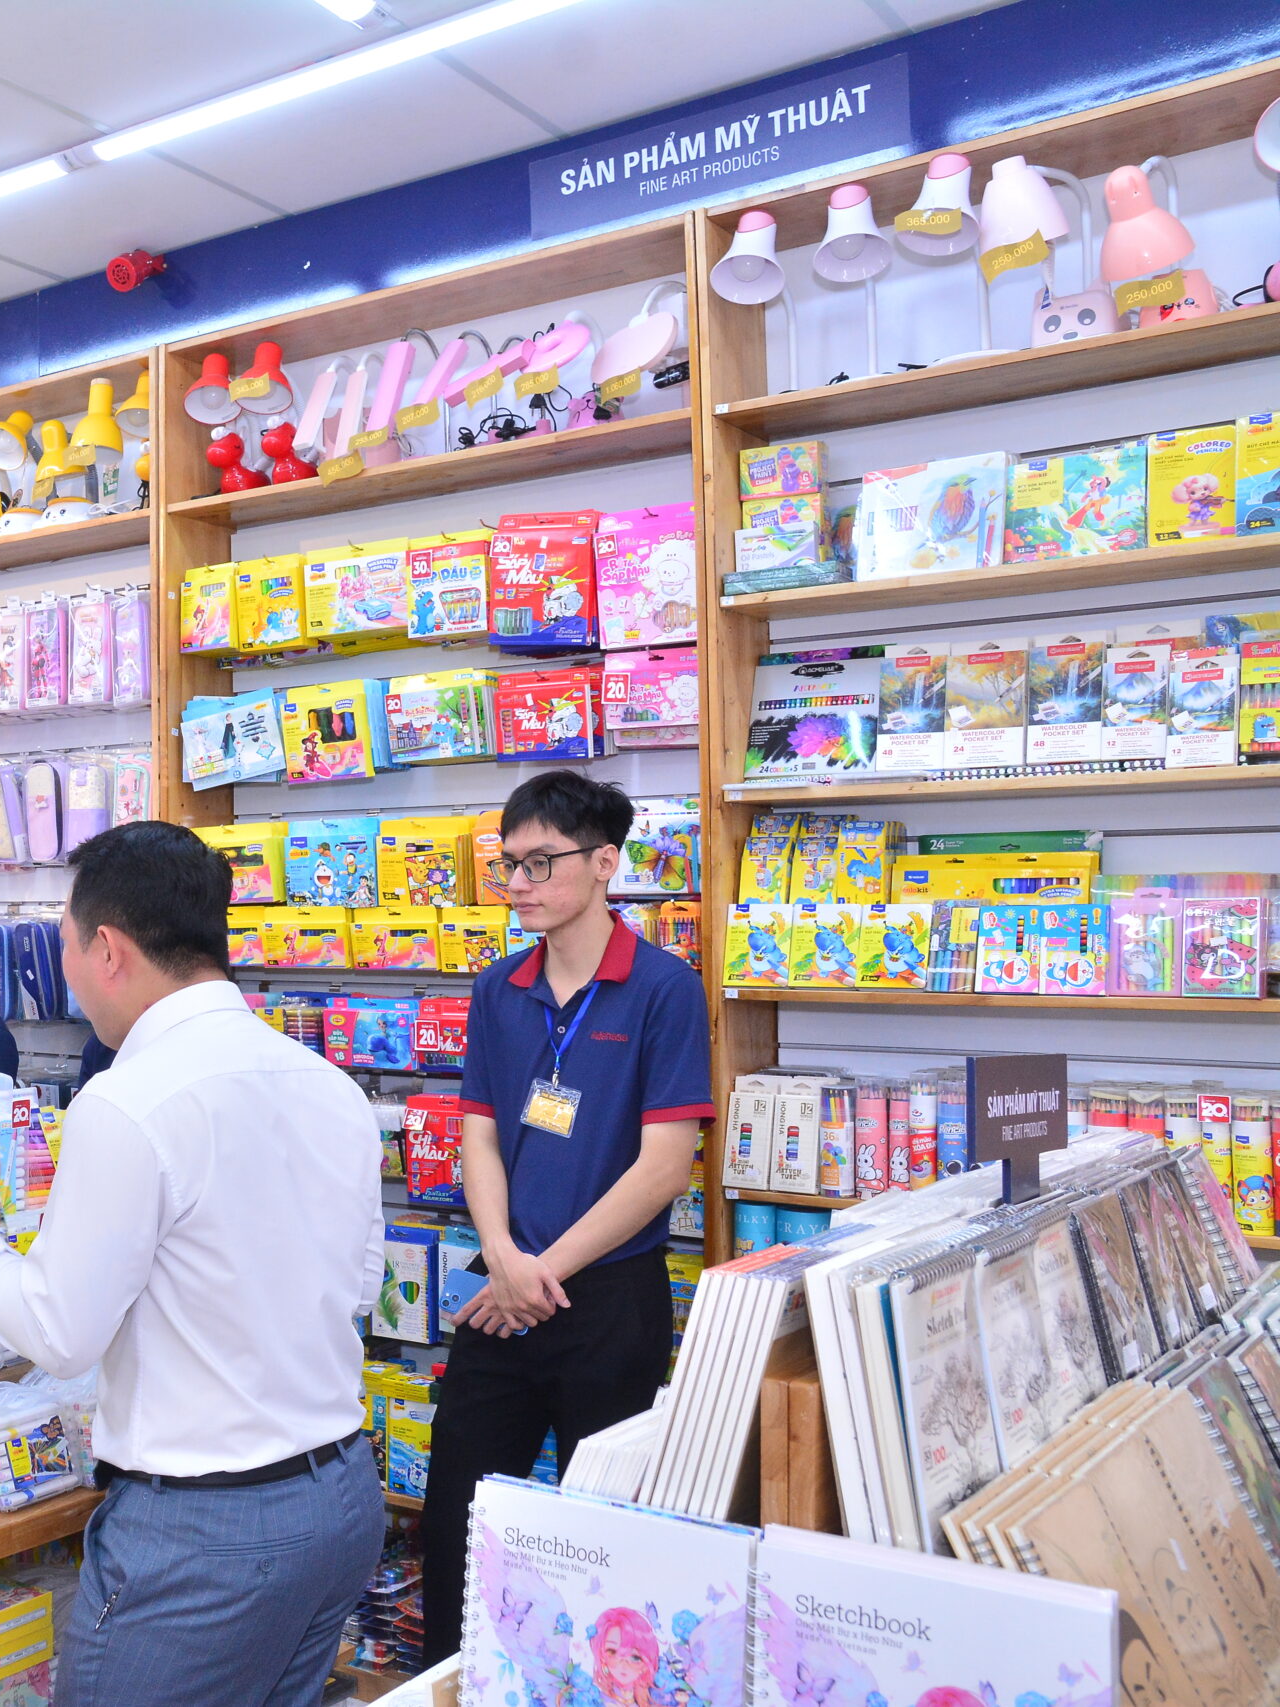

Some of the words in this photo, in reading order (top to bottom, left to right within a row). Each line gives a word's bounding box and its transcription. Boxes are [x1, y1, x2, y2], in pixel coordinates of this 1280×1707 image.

[561, 158, 615, 196] SẢN
[624, 131, 706, 178] PHẨM
[715, 113, 761, 154] MỸ
[768, 84, 872, 137] THUẬT
[639, 178, 668, 196] FINE
[671, 167, 698, 188] ART
[703, 145, 780, 179] PRODUCTS
[992, 240, 1034, 270] 250.000
[1126, 279, 1173, 304] 250.000
[1187, 440, 1232, 454] COLORED
[749, 463, 776, 476] PROJECT
[802, 473, 809, 482] 6
[752, 515, 779, 527] PROJECT
[1249, 520, 1261, 528] 24
[1039, 542, 1057, 551] Basic
[740, 553, 750, 562] Oil
[751, 551, 775, 561] Pastels
[741, 563, 750, 572] 12
[961, 729, 1006, 738] WATERCOLOR
[1041, 723, 1088, 732] WATERCOLOR
[889, 733, 933, 742] WATERCOLOR
[1180, 733, 1220, 741] WATERCOLOR
[1033, 740, 1046, 748] 48
[759, 765, 769, 774] 24
[929, 838, 945, 851] 24
[334, 1052, 345, 1061] 18
[753, 1099, 767, 1112] 12
[800, 1102, 814, 1114] 12
[987, 1095, 1004, 1118] SẢN
[1004, 1086, 1026, 1115] PHẨM
[1026, 1090, 1037, 1113] MỸ
[1038, 1088, 1060, 1112] THUẬT
[779, 1101, 787, 1123] HONG
[731, 1119, 739, 1131] HA
[778, 1124, 785, 1135] HA
[1001, 1125, 1013, 1141] FINE
[1013, 1123, 1023, 1140] ART
[1023, 1120, 1048, 1139] PRODUCTS
[408, 1130, 433, 1147] CHÌ
[823, 1131, 835, 1141] 36
[411, 1145, 450, 1161] MÀU
[737, 1213, 769, 1224] ILKY
[391, 1260, 400, 1269] 18
[504, 1526, 611, 1568] Sketchbook
[503, 1559, 523, 1570] Made
[535, 1567, 567, 1581] Vietnam
[795, 1593, 932, 1642] Sketchbook
[836, 1639, 878, 1656] Vietnam
